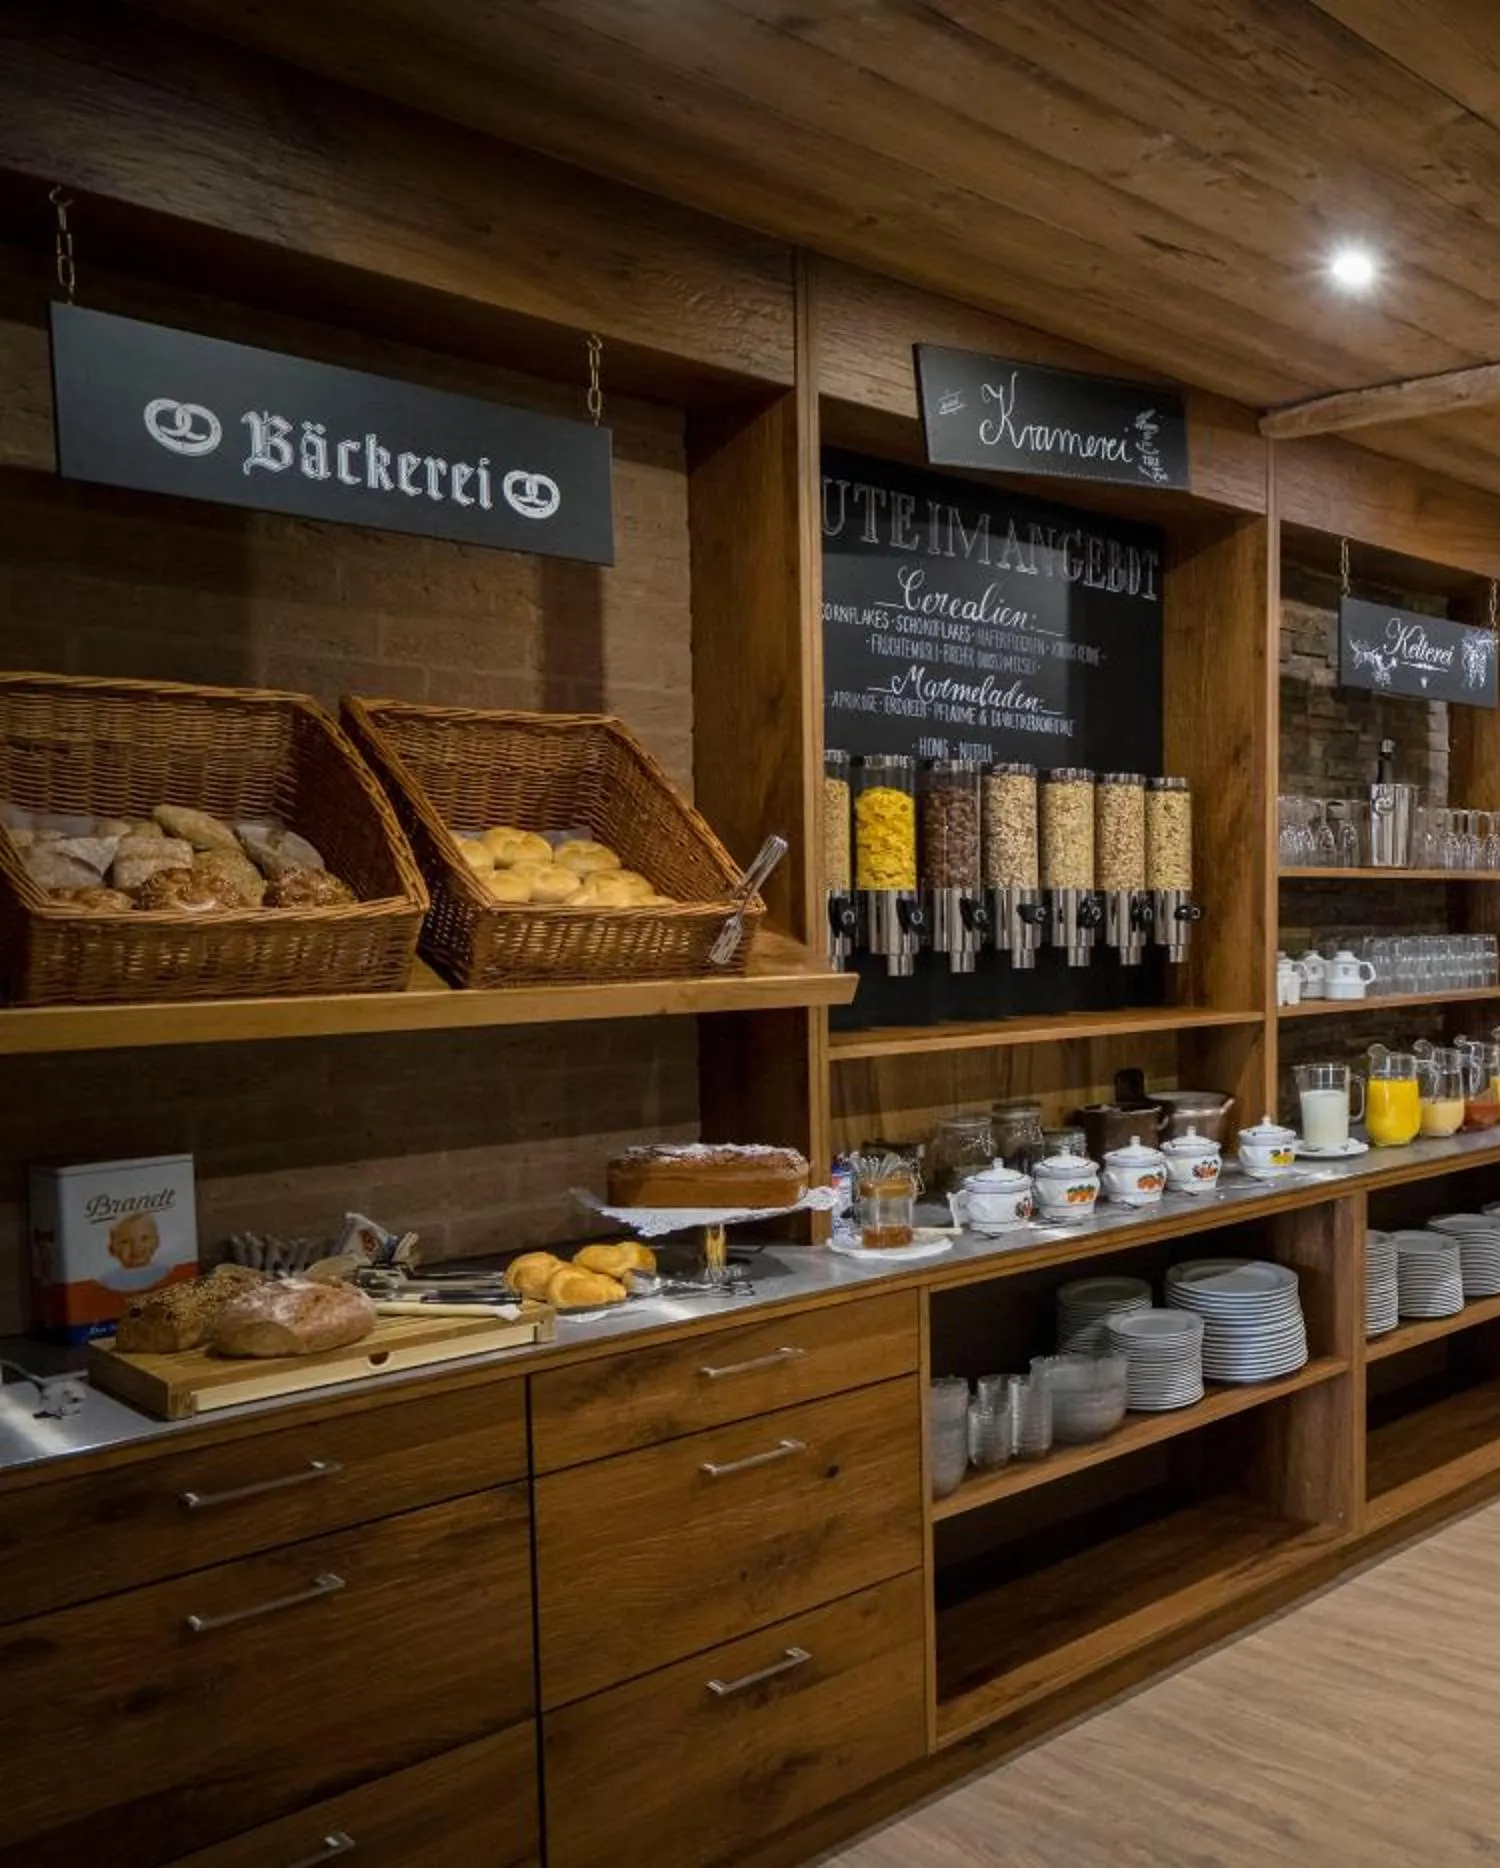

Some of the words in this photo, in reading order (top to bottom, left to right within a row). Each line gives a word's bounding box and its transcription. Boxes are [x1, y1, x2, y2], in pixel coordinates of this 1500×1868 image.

[240, 409, 494, 511] Bäckerei
[927, 500, 991, 564] IM
[996, 514, 1158, 600] ANGEBOT
[84, 1187, 176, 1219] Brandt
